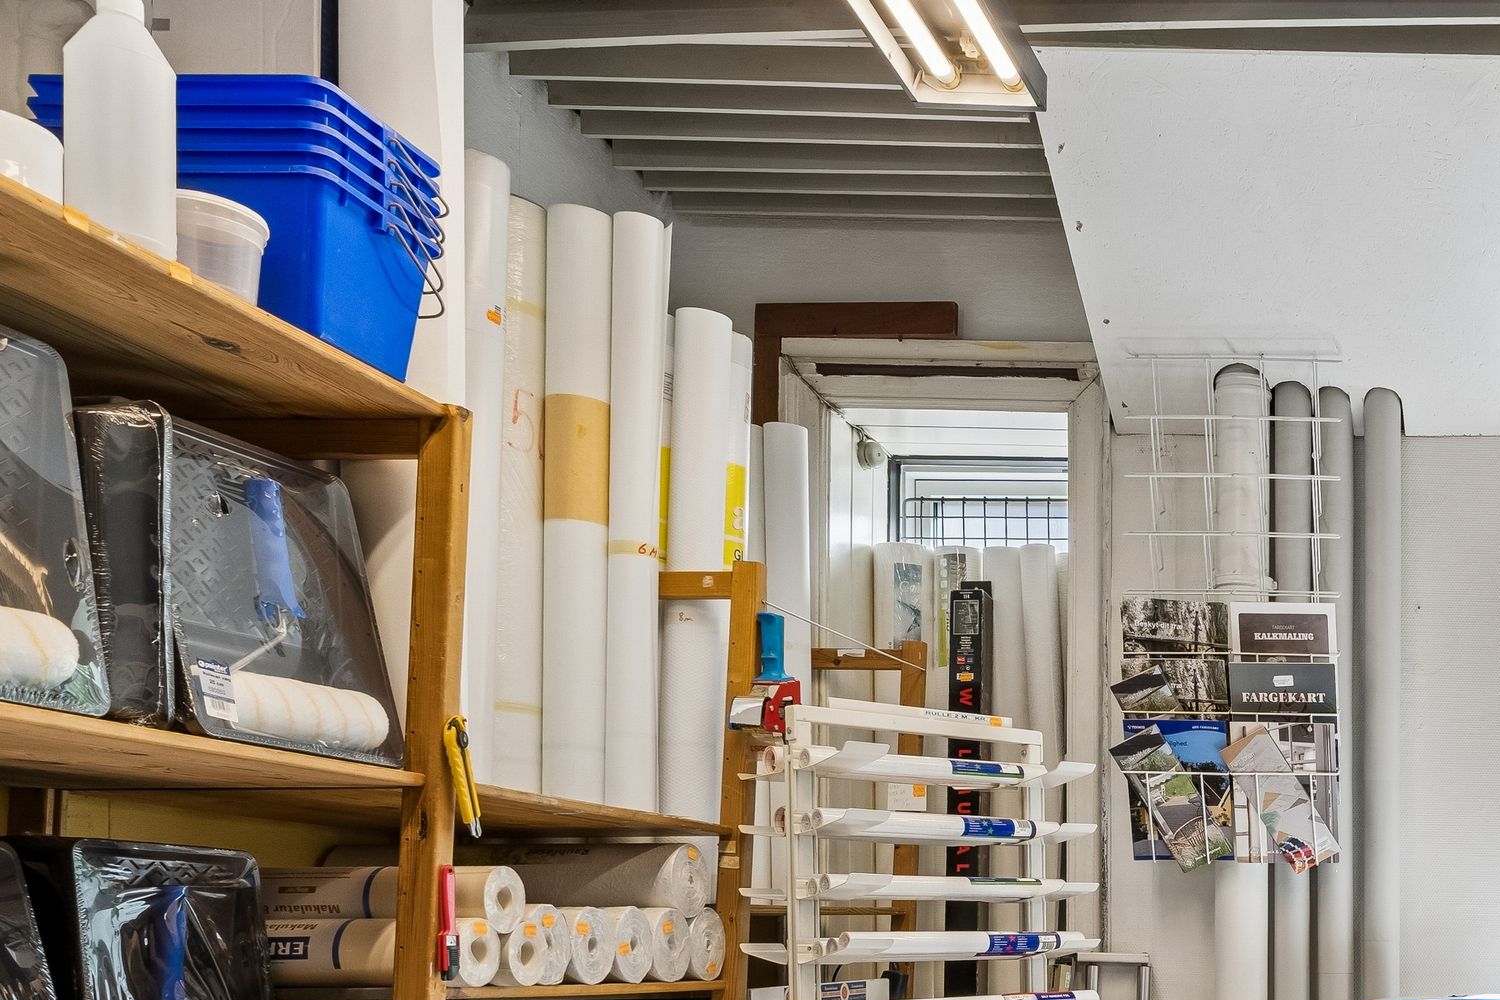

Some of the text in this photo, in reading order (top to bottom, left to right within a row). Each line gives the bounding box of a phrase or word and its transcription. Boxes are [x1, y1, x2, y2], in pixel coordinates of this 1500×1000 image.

[1254, 632, 1315, 642] KALKMALING
[1242, 692, 1326, 704] FARGEKART
[273, 904, 341, 914] Makulatur
[266, 923, 318, 931] Makula
